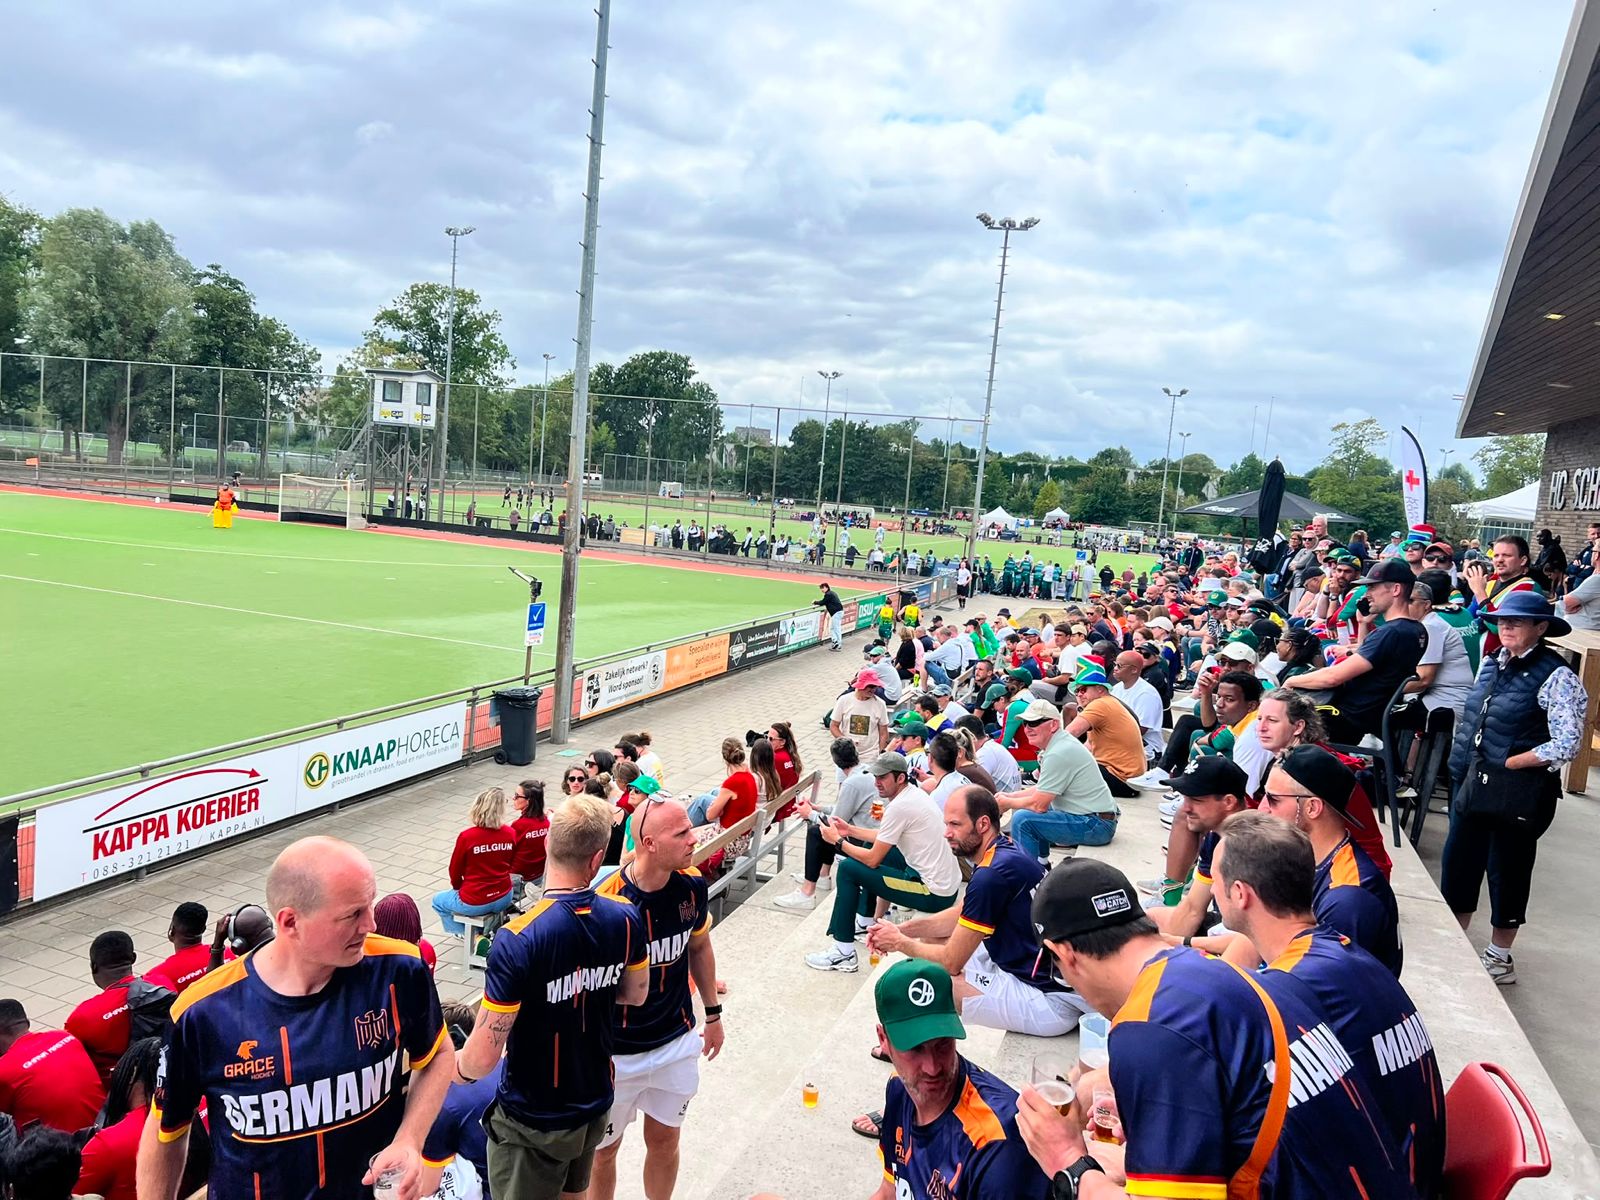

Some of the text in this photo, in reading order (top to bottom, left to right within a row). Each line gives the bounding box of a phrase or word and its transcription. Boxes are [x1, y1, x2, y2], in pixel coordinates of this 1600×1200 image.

[1549, 466, 1600, 510] HC SCH
[605, 667, 626, 681] Zakelijk
[608, 681, 623, 693] Word
[92, 787, 260, 861] KAPPA KOERIER
[209, 815, 267, 841] KAPPA.NL
[473, 843, 513, 855] BELGIUM
[546, 962, 624, 1004] MANAMAS
[103, 1004, 129, 1020] GHAN
[22, 1051, 49, 1069] GHANA
[224, 1056, 275, 1078] GRACE
[250, 1070, 276, 1081] HOCKEY
[220, 1048, 398, 1136] GERMANY
